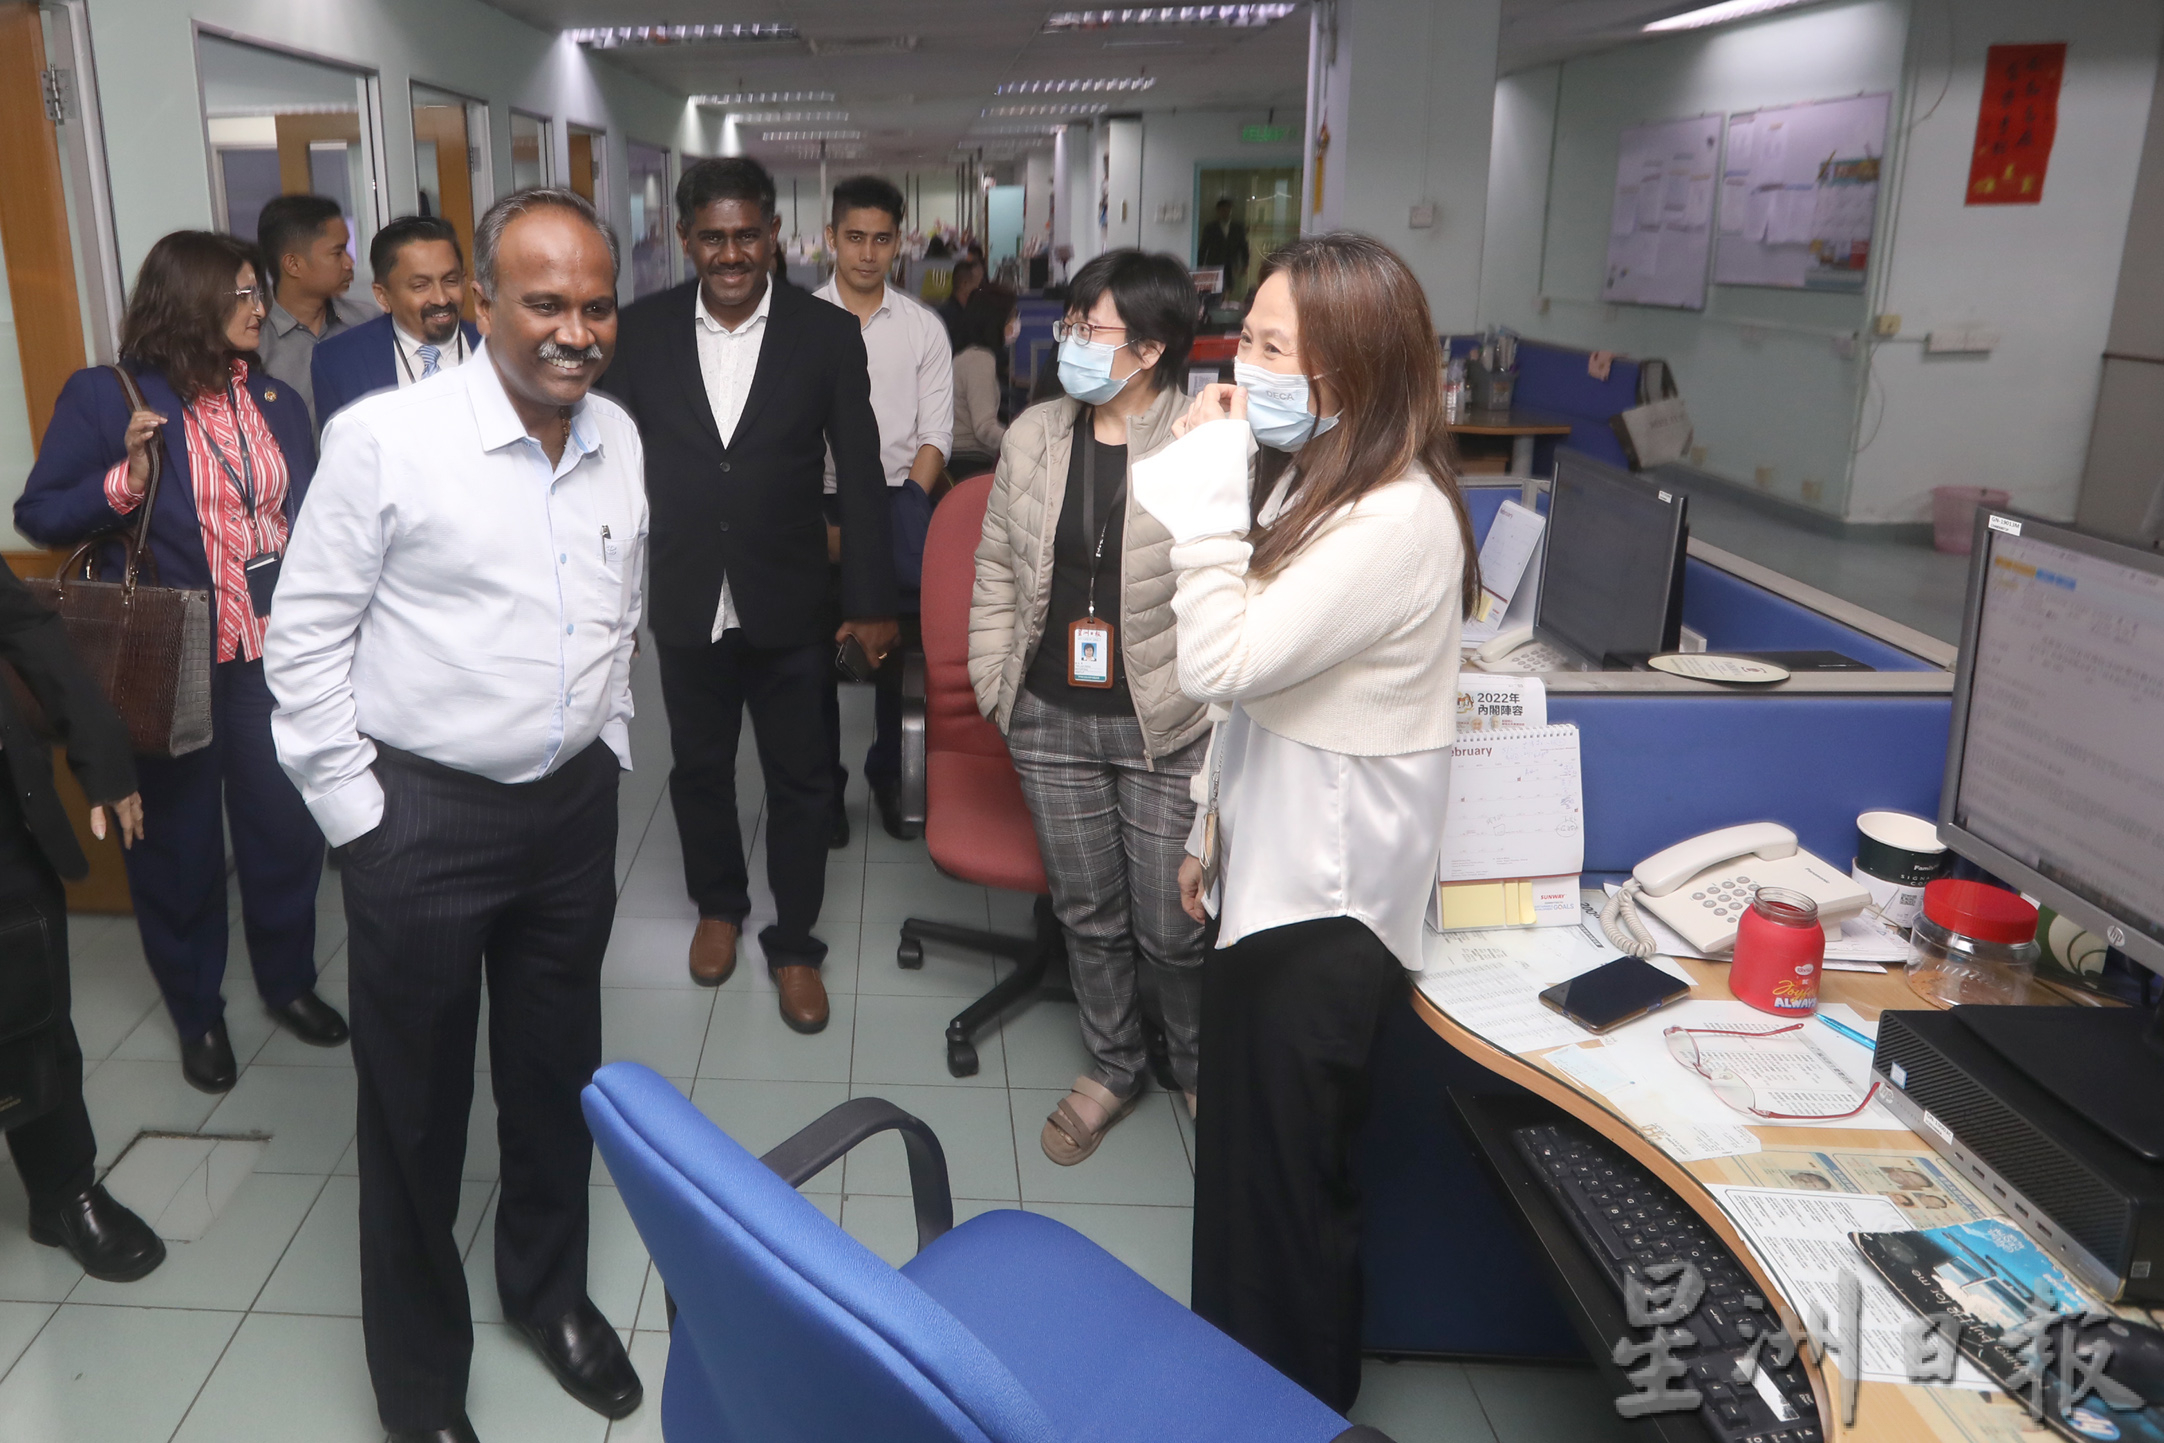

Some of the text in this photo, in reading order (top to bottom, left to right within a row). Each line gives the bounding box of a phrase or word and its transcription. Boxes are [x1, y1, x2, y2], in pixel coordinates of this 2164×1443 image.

[1266, 390, 1295, 401] DECA
[1477, 692, 1520, 704] 2022年
[1911, 1268, 1931, 1286] me
[1930, 1287, 1952, 1305] for
